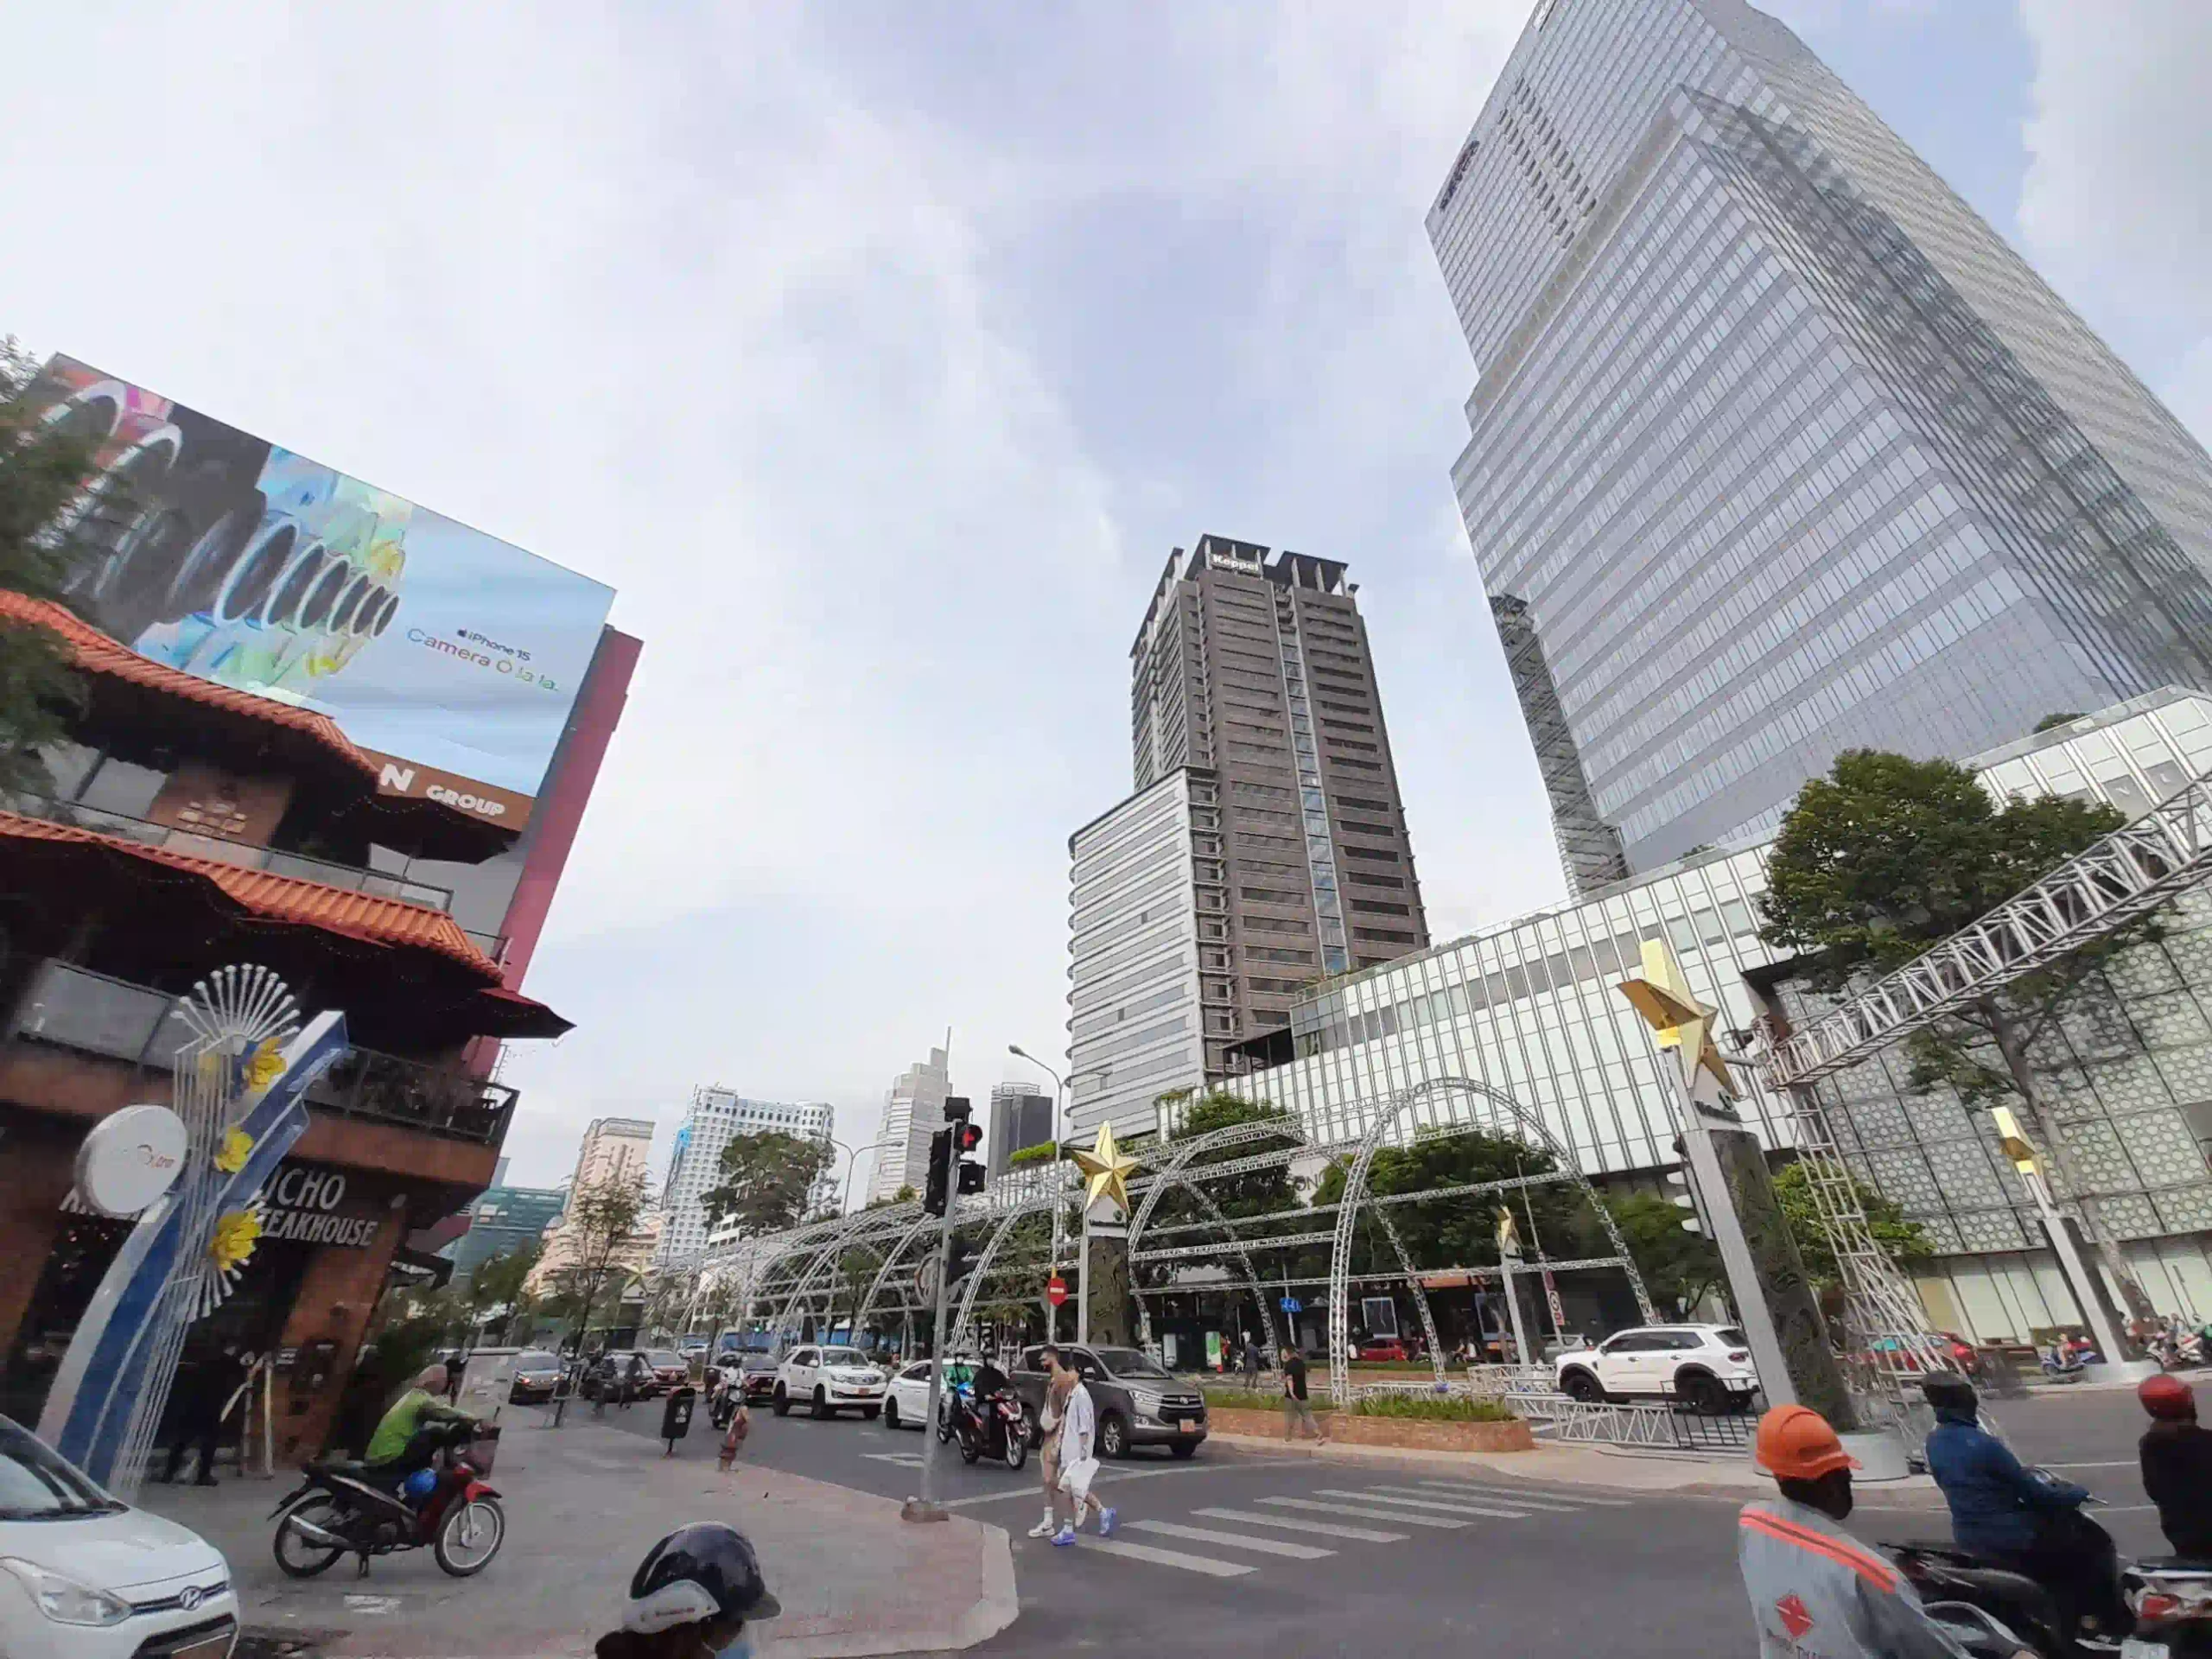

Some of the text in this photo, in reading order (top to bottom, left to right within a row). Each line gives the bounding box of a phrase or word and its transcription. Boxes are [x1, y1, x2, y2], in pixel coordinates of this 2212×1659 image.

[407, 628, 492, 668] Camera
[467, 631, 531, 662] iPhone 15
[379, 763, 506, 817] N GROUP
[257, 1207, 378, 1247] TEAKHOUSE
